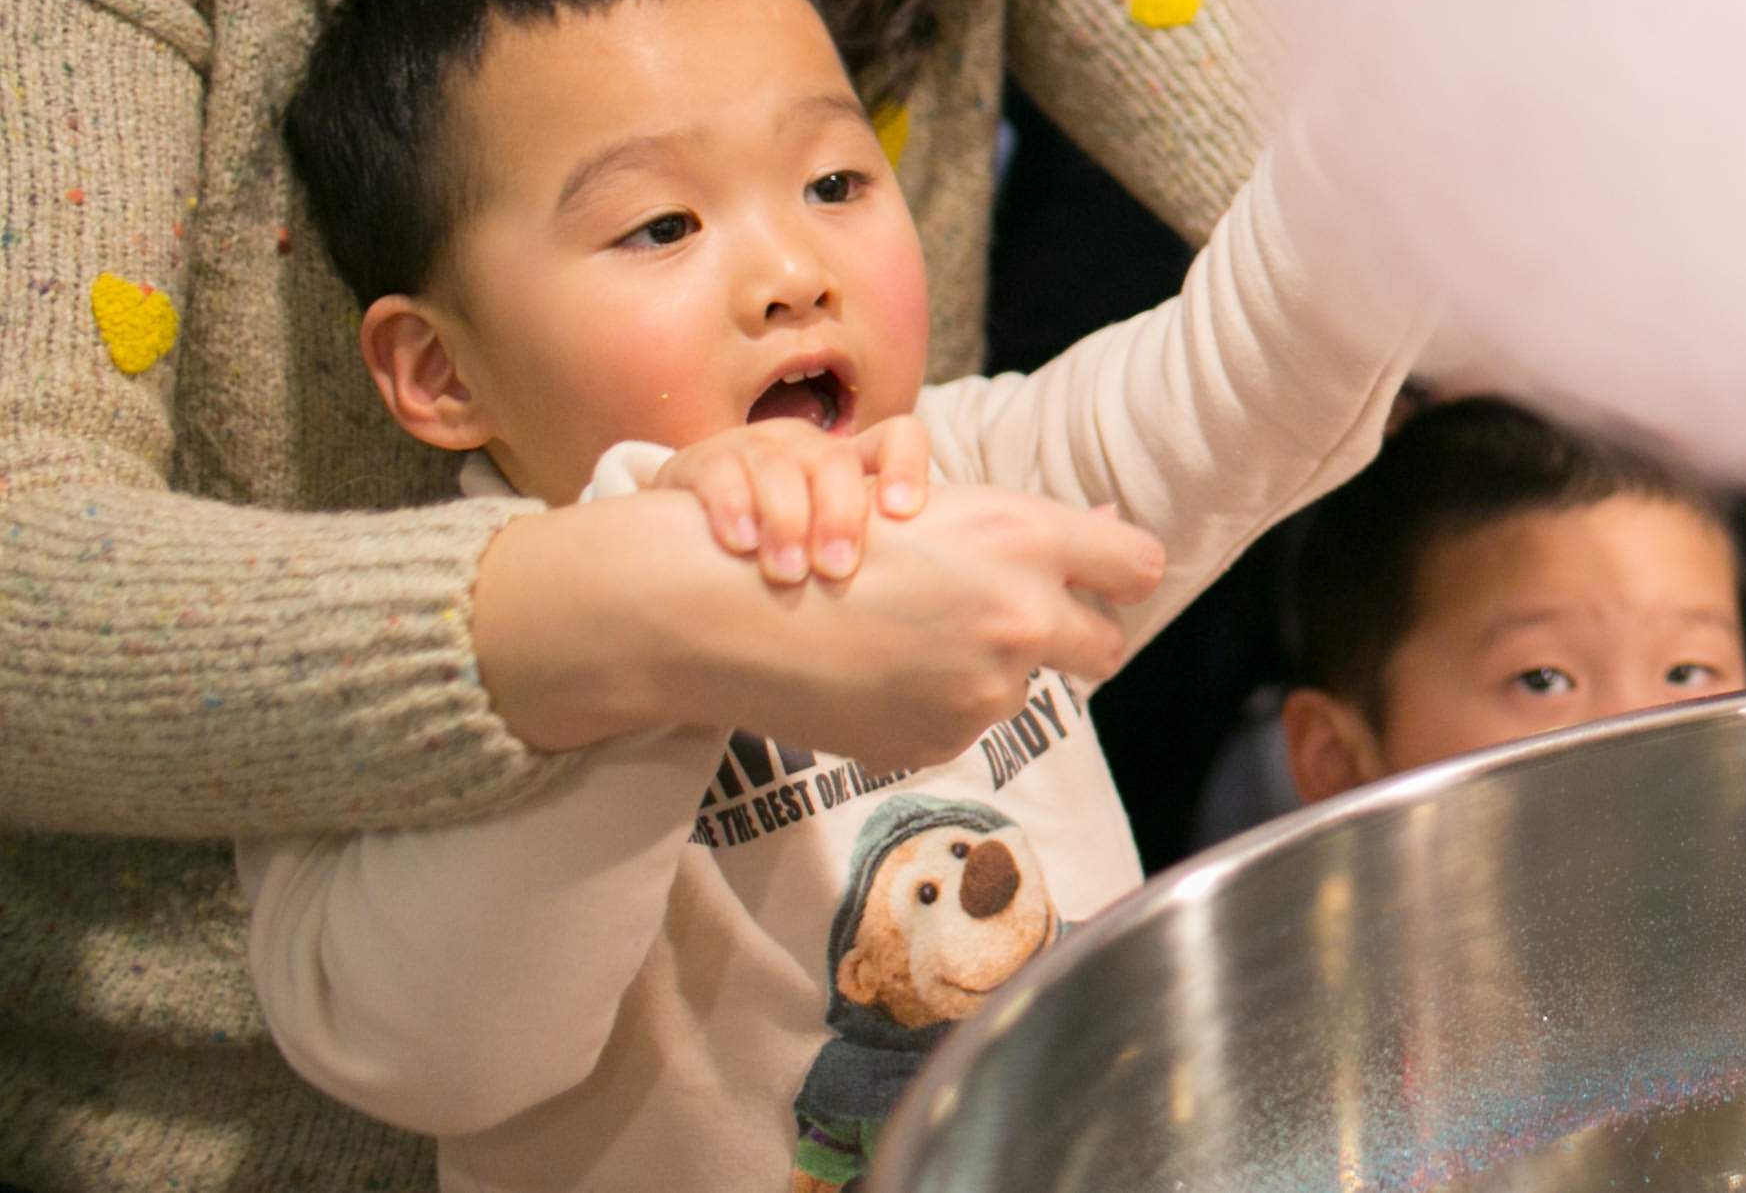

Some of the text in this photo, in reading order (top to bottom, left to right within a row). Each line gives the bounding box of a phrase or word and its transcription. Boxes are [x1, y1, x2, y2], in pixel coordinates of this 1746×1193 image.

[979, 687, 1068, 791] DANDY
[716, 802, 760, 846] THE
[752, 779, 815, 833] BEST
